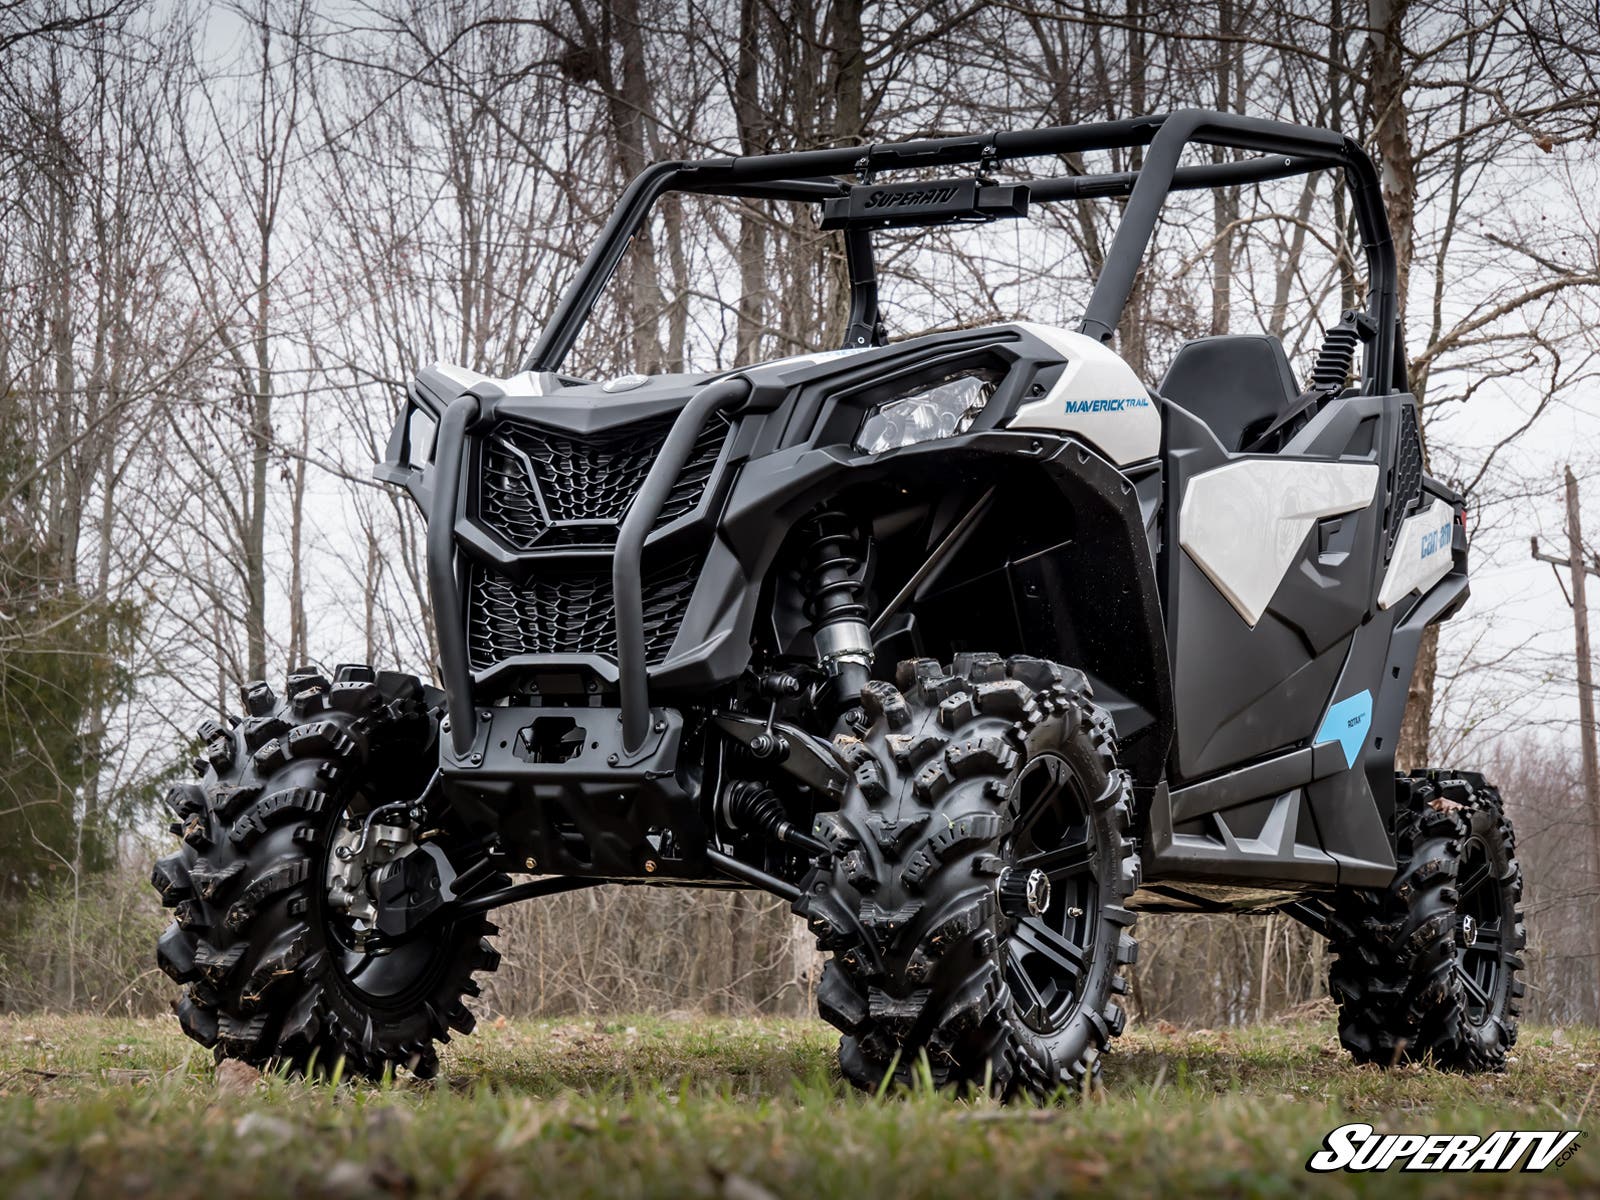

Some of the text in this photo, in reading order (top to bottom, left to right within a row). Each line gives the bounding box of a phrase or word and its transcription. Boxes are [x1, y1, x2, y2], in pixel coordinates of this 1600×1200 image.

[864, 188, 957, 209] SUPERATV
[1065, 398, 1149, 413] MAVERICK TRAIL
